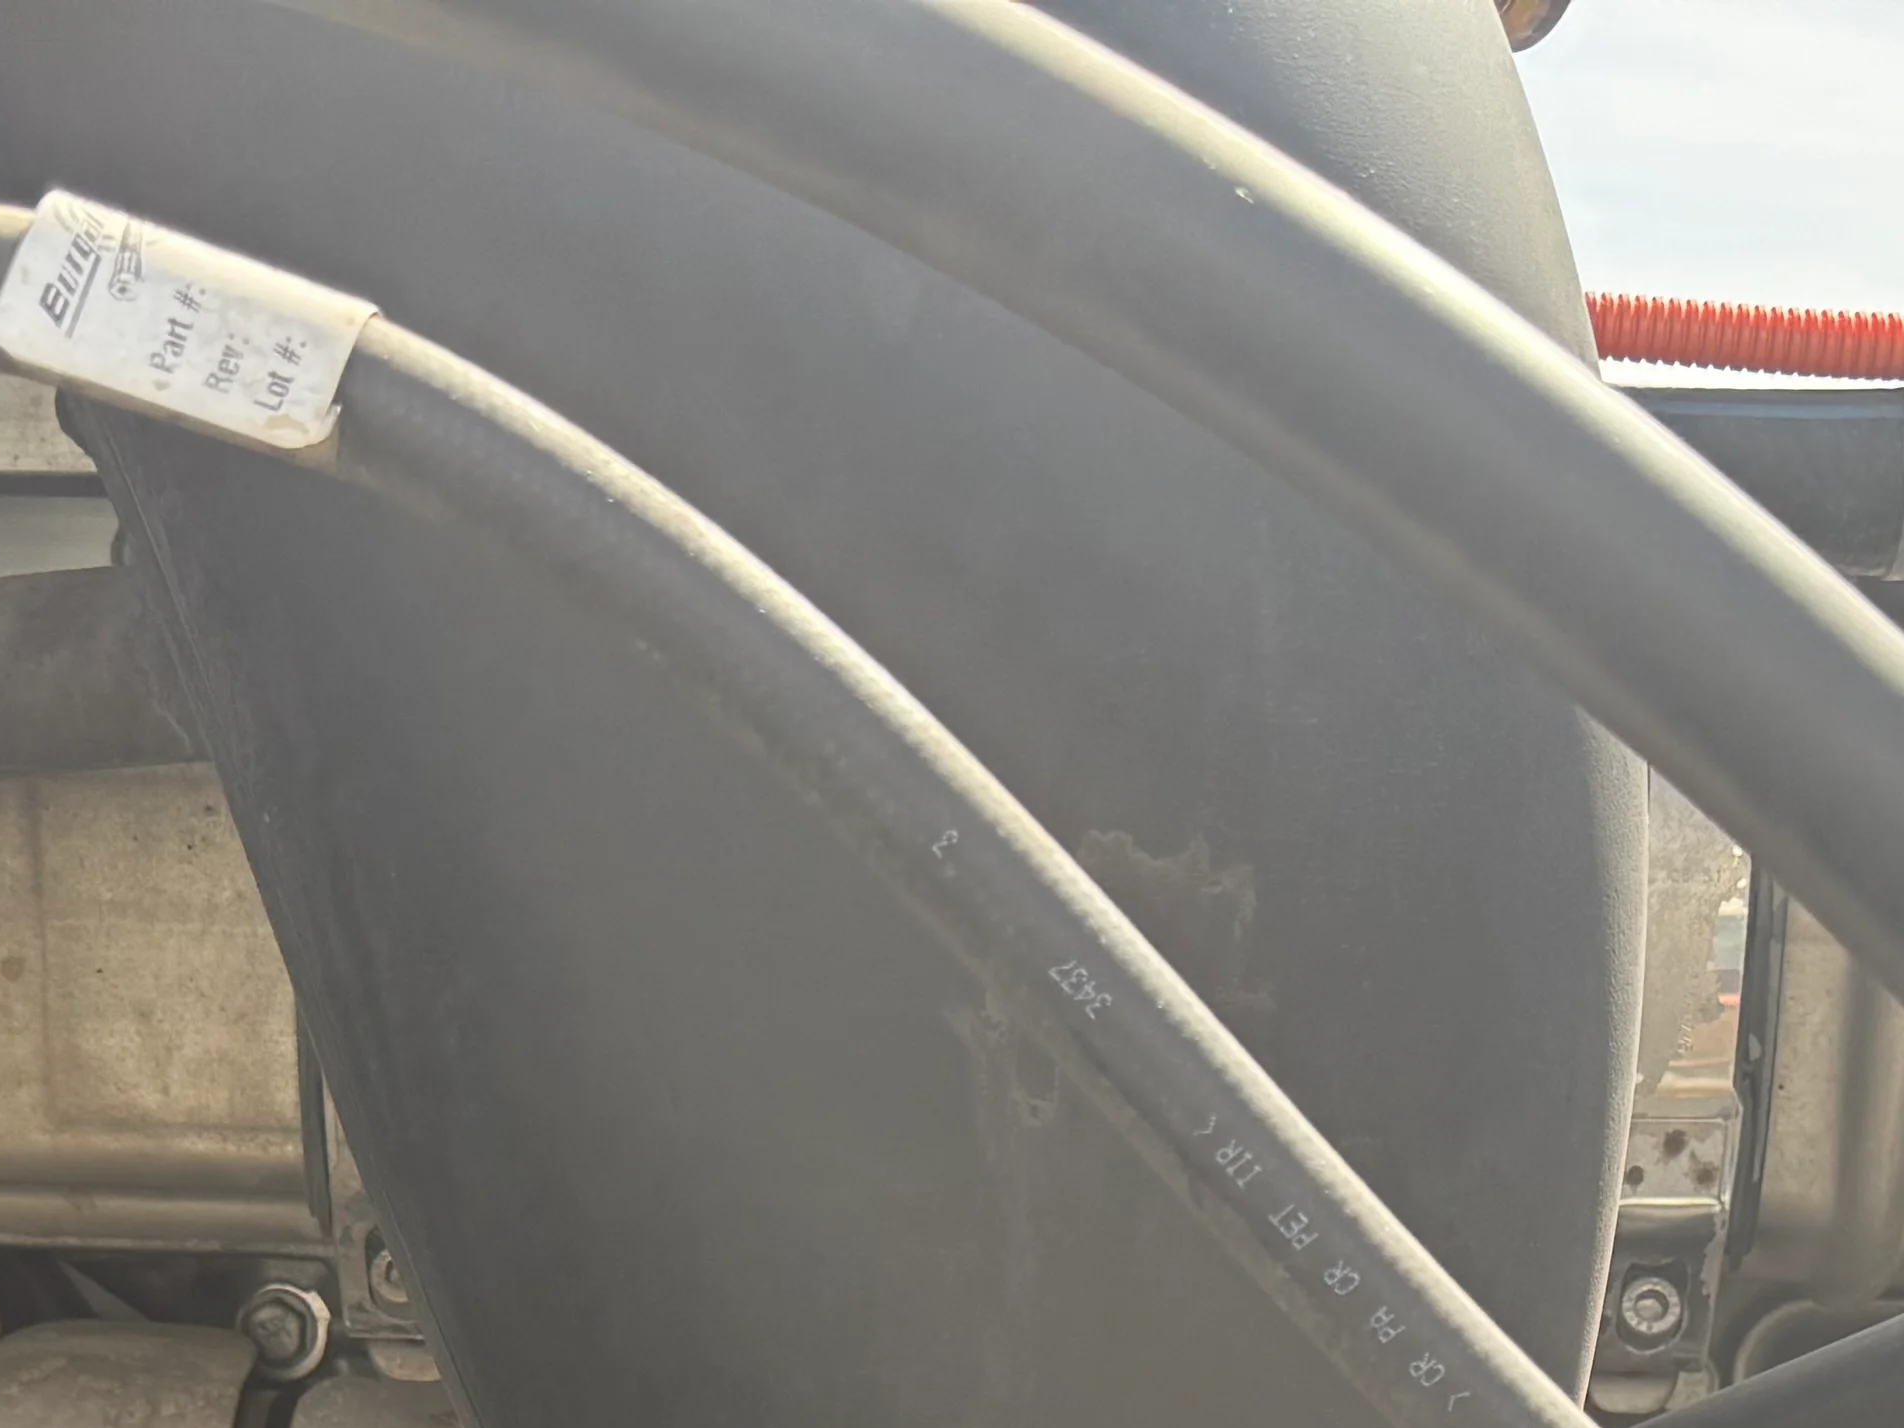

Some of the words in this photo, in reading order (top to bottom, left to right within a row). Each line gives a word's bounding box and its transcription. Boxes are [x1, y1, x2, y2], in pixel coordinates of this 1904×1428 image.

[149, 316, 194, 375] Part
[202, 333, 250, 394] Rev:
[254, 370, 295, 412] Lot
[1048, 959, 1112, 1019] 3437
[1268, 1204, 1319, 1250] PET
[1323, 1259, 1361, 1296] CR
[1369, 1306, 1406, 1344] PA
[1408, 1352, 1446, 1388] CR
